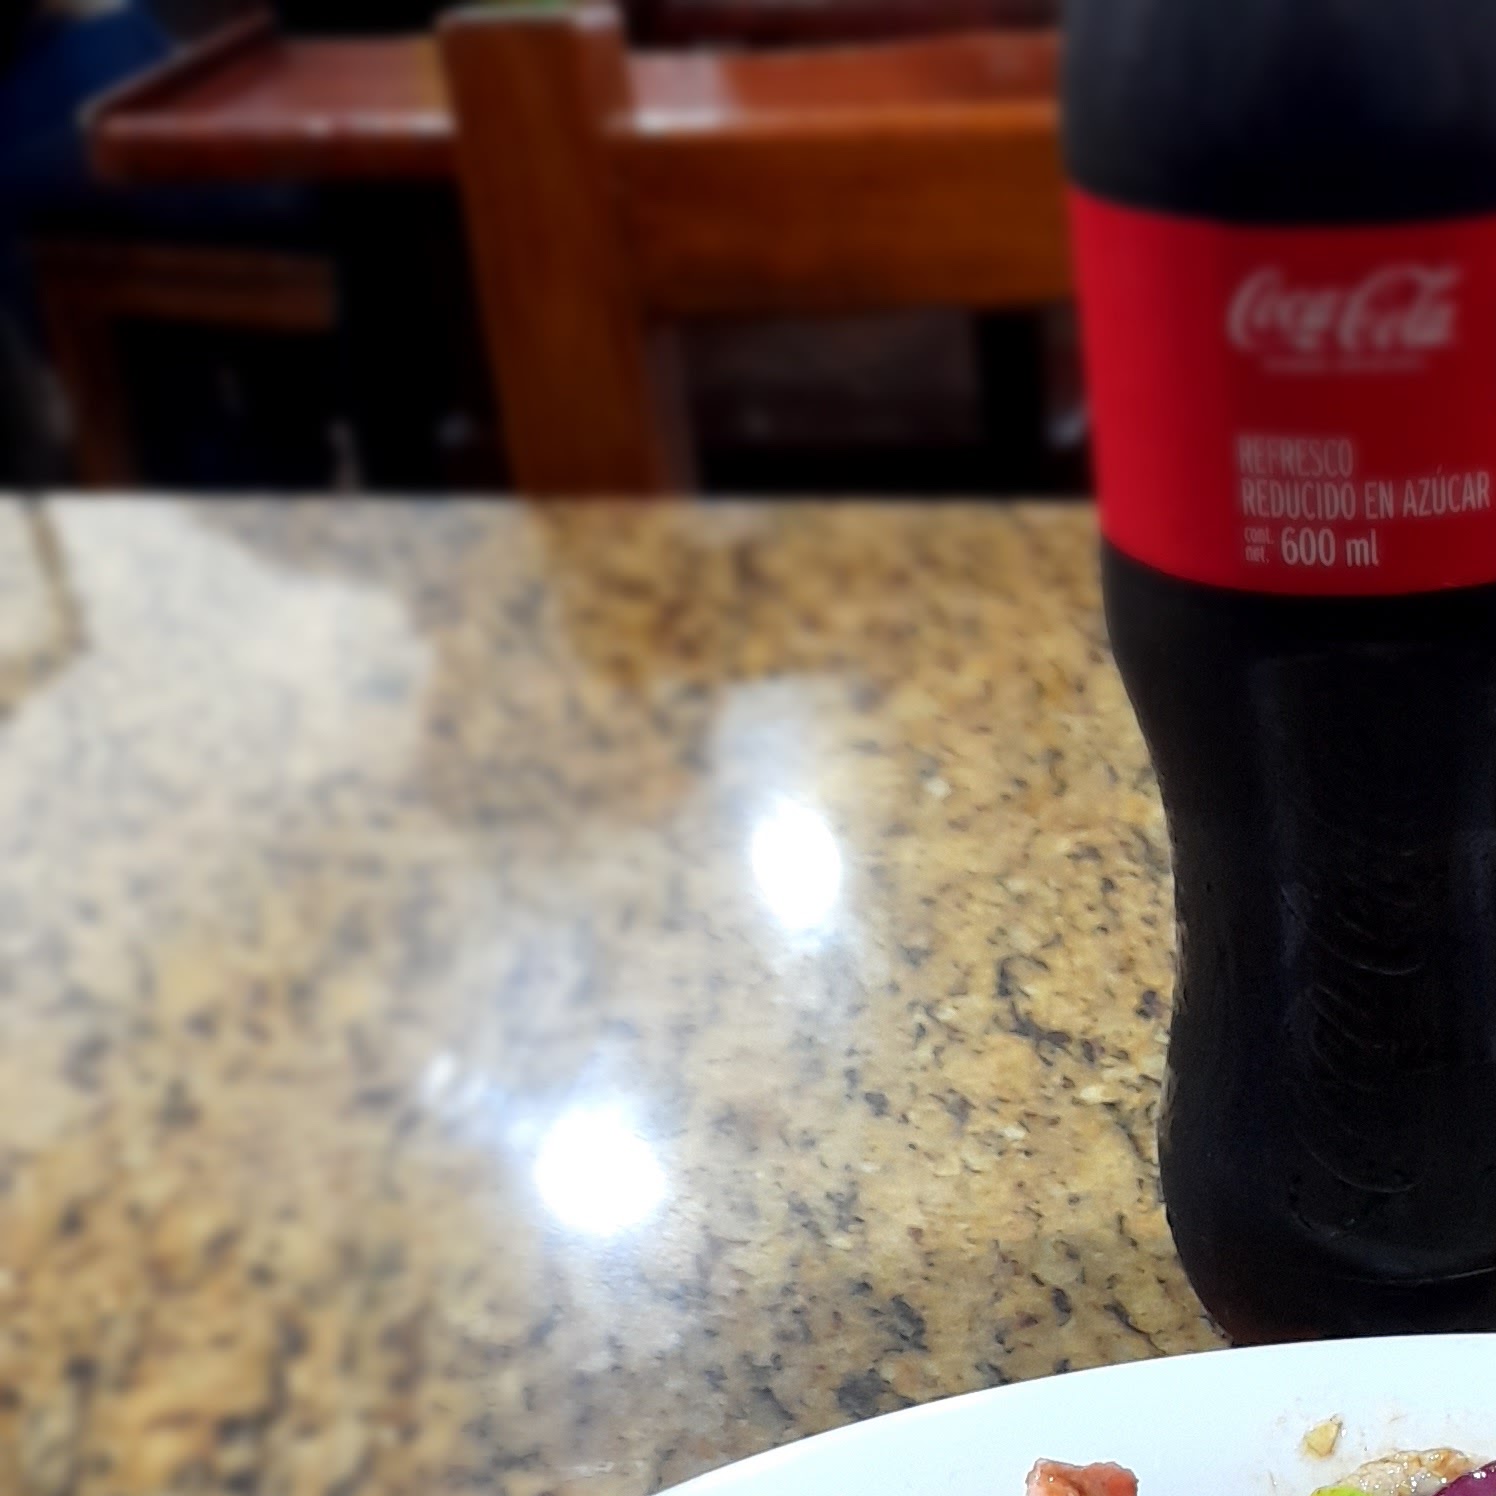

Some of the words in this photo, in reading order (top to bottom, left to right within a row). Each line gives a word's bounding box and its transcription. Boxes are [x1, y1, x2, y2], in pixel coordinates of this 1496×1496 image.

[1239, 437, 1355, 479] REFRESCO
[1242, 478, 1357, 521] REDUCIDO
[1364, 481, 1394, 520] EN
[1403, 464, 1491, 518] AZÚCAR
[1281, 526, 1336, 567] 600
[1345, 528, 1380, 567] ml
